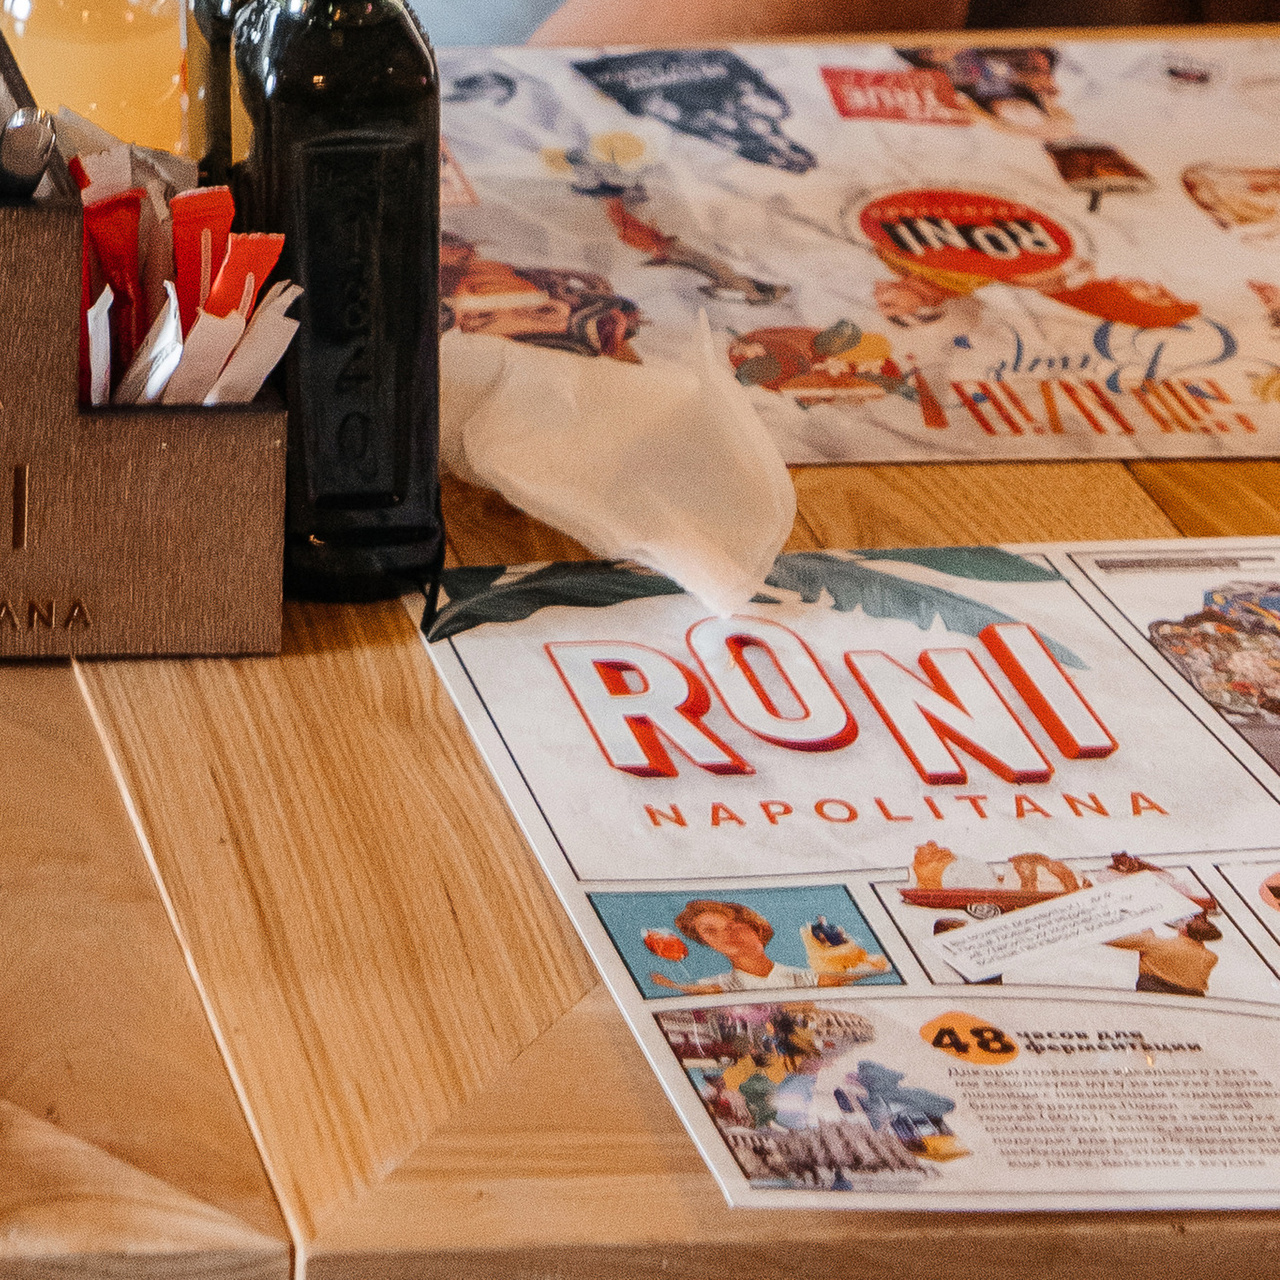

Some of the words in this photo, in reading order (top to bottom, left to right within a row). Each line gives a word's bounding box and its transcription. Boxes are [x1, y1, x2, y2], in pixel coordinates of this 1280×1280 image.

[880, 216, 1062, 260] RONI
[543, 616, 1119, 785] RONI
[644, 789, 1169, 828] NAPOLITANA
[932, 1026, 1016, 1054] 48
